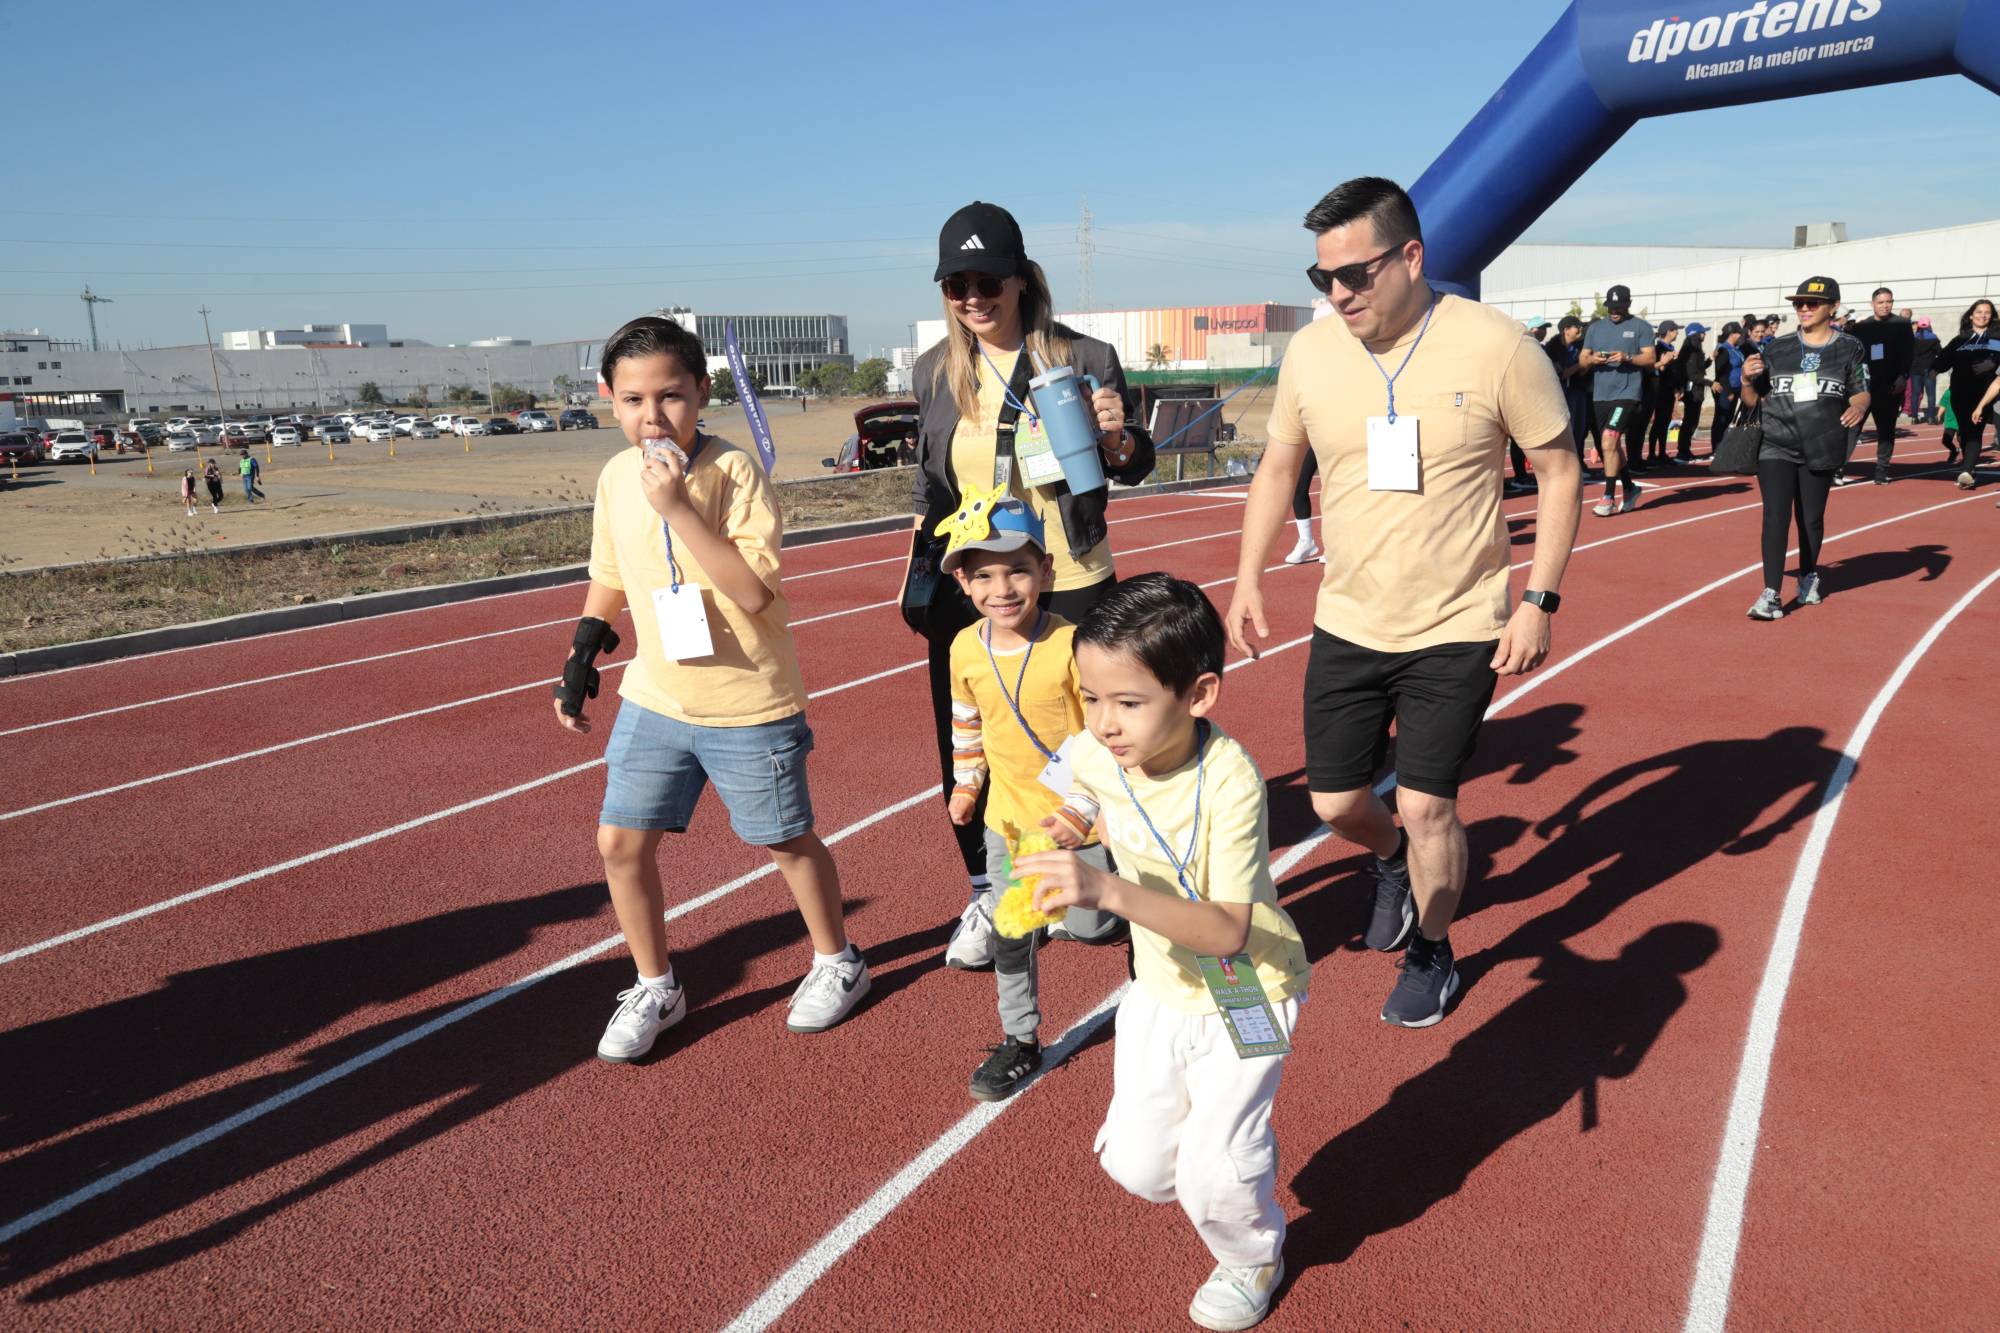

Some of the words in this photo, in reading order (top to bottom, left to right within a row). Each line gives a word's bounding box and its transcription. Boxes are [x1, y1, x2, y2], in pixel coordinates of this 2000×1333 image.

[1628, 0, 1881, 63] dportenis
[1684, 59, 1744, 80] Alcanza
[1747, 54, 1763, 71] la
[1765, 46, 1816, 68] mejor
[1818, 35, 1875, 59] marca
[1211, 317, 1258, 331] Liverpool
